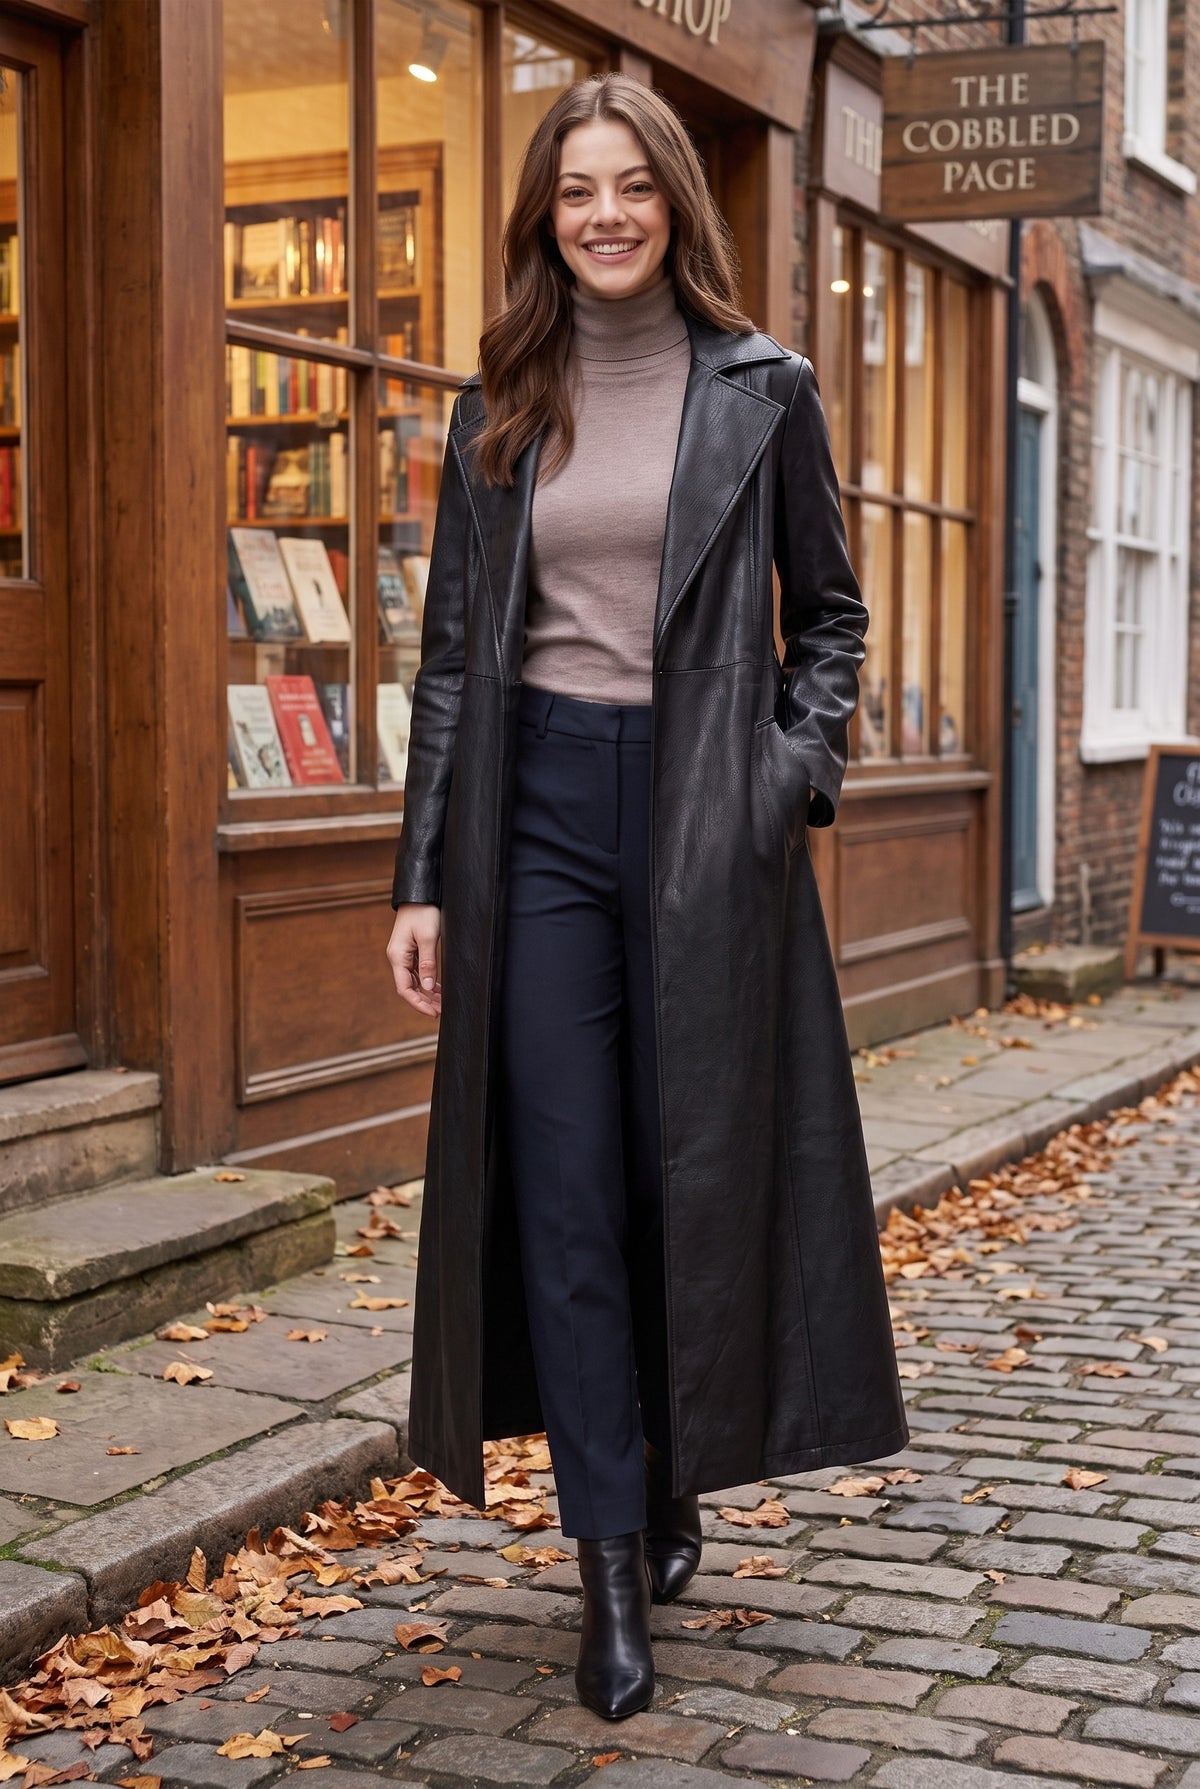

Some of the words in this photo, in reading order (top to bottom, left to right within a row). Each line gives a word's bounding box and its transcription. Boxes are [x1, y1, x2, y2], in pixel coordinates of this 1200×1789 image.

[952, 73, 1029, 107] THE
[902, 113, 1080, 153] COBBLED
[944, 157, 1036, 193] PAGE
